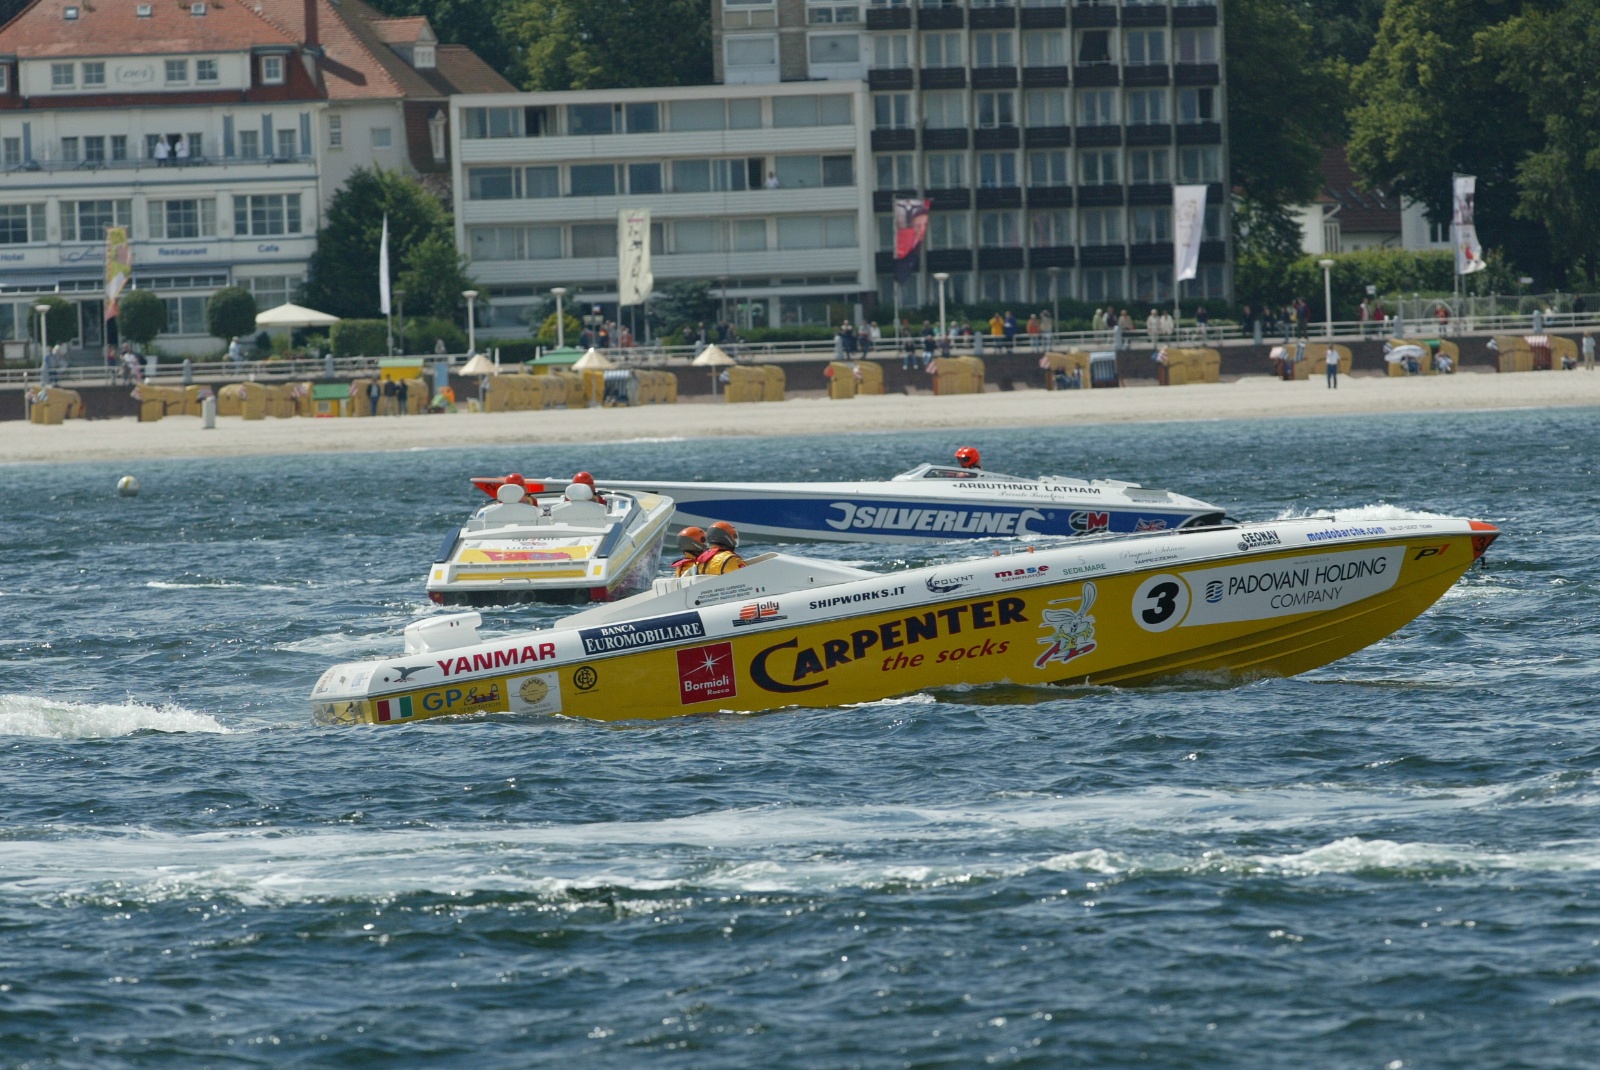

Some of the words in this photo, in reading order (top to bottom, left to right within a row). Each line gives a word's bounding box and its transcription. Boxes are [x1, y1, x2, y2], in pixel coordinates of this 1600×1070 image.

[1, 252, 25, 261] Hotel
[158, 247, 208, 257] Restaurant
[958, 482, 1039, 491] ARBUTHNOT
[1044, 485, 1101, 494] LATHAM
[1241, 530, 1279, 543] GEONAV
[1306, 526, 1387, 542] mondobarche.com
[994, 565, 1050, 578] mase
[1062, 563, 1107, 576] SEDILMARE
[1228, 568, 1309, 596] PADOVANI
[1314, 556, 1387, 584] HOLDING
[934, 574, 975, 586] POLYNT
[809, 585, 906, 610] SHIPWORKS.IT
[1142, 581, 1180, 625] 3
[1271, 586, 1343, 609] COMPANY
[585, 622, 702, 653] EUROMOBILIARE
[601, 624, 636, 636] BANCA
[750, 596, 1029, 693] CARPENTER
[436, 642, 556, 677] YANMAR
[881, 651, 925, 672] the
[935, 638, 1011, 664] socks
[684, 674, 730, 692] Bormioli
[707, 687, 730, 696] Rocco
